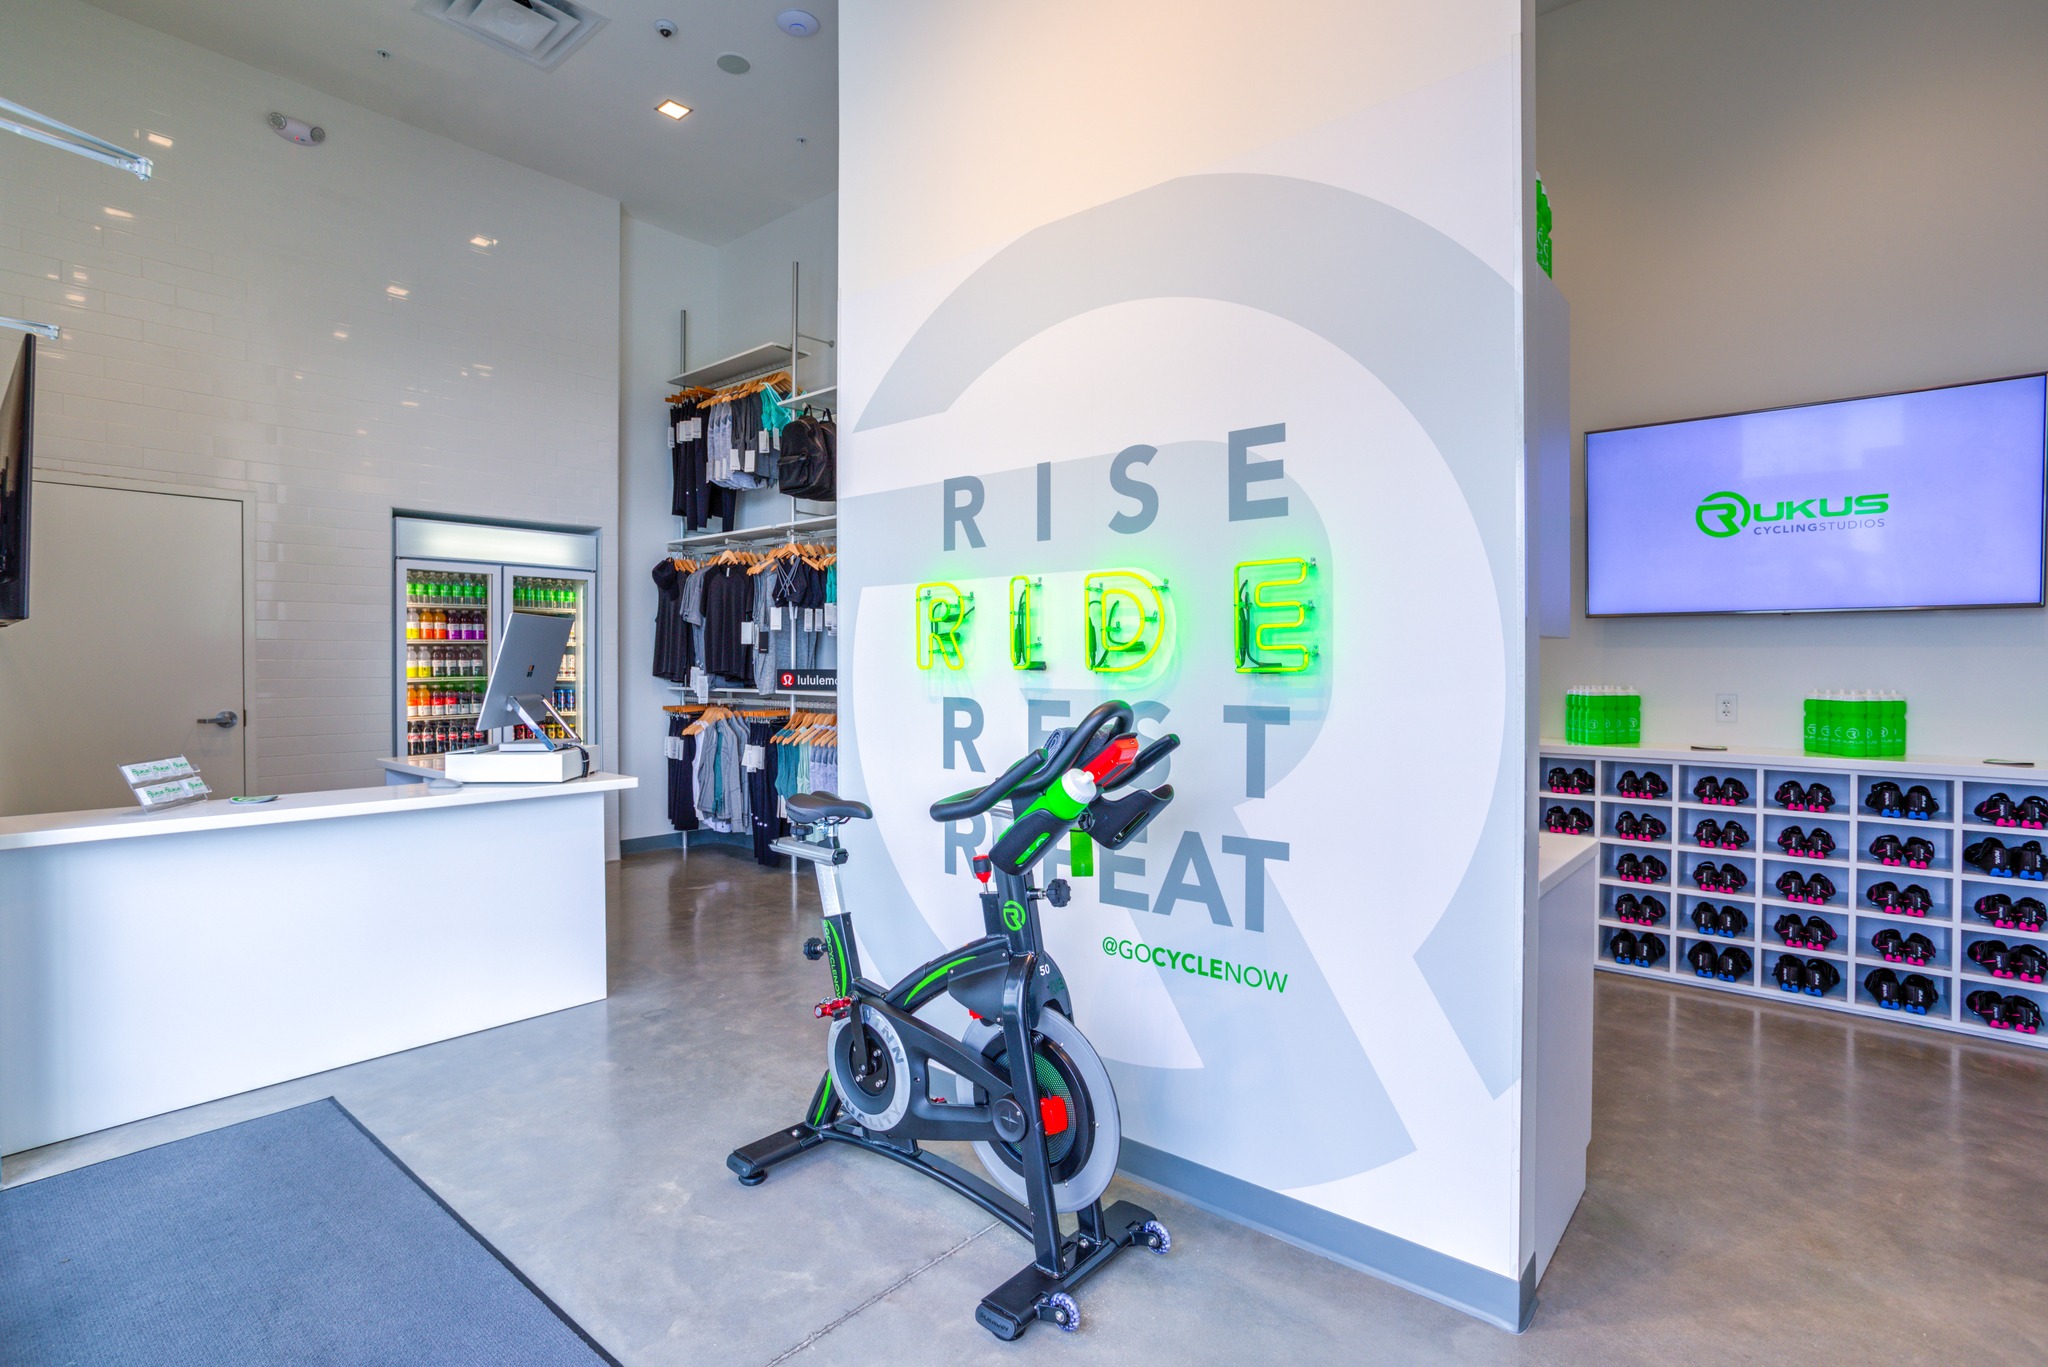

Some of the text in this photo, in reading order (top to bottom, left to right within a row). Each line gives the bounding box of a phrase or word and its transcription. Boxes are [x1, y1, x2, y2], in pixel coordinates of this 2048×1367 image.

[943, 423, 1288, 551] RISE
[1753, 518, 1886, 536] CYCLINGSTUDIOS
[915, 558, 1308, 674] RIDE
[944, 812, 1290, 933] REAT
[1039, 963, 1050, 976] 50
[1102, 936, 1288, 993] @GOCYCLENOW
